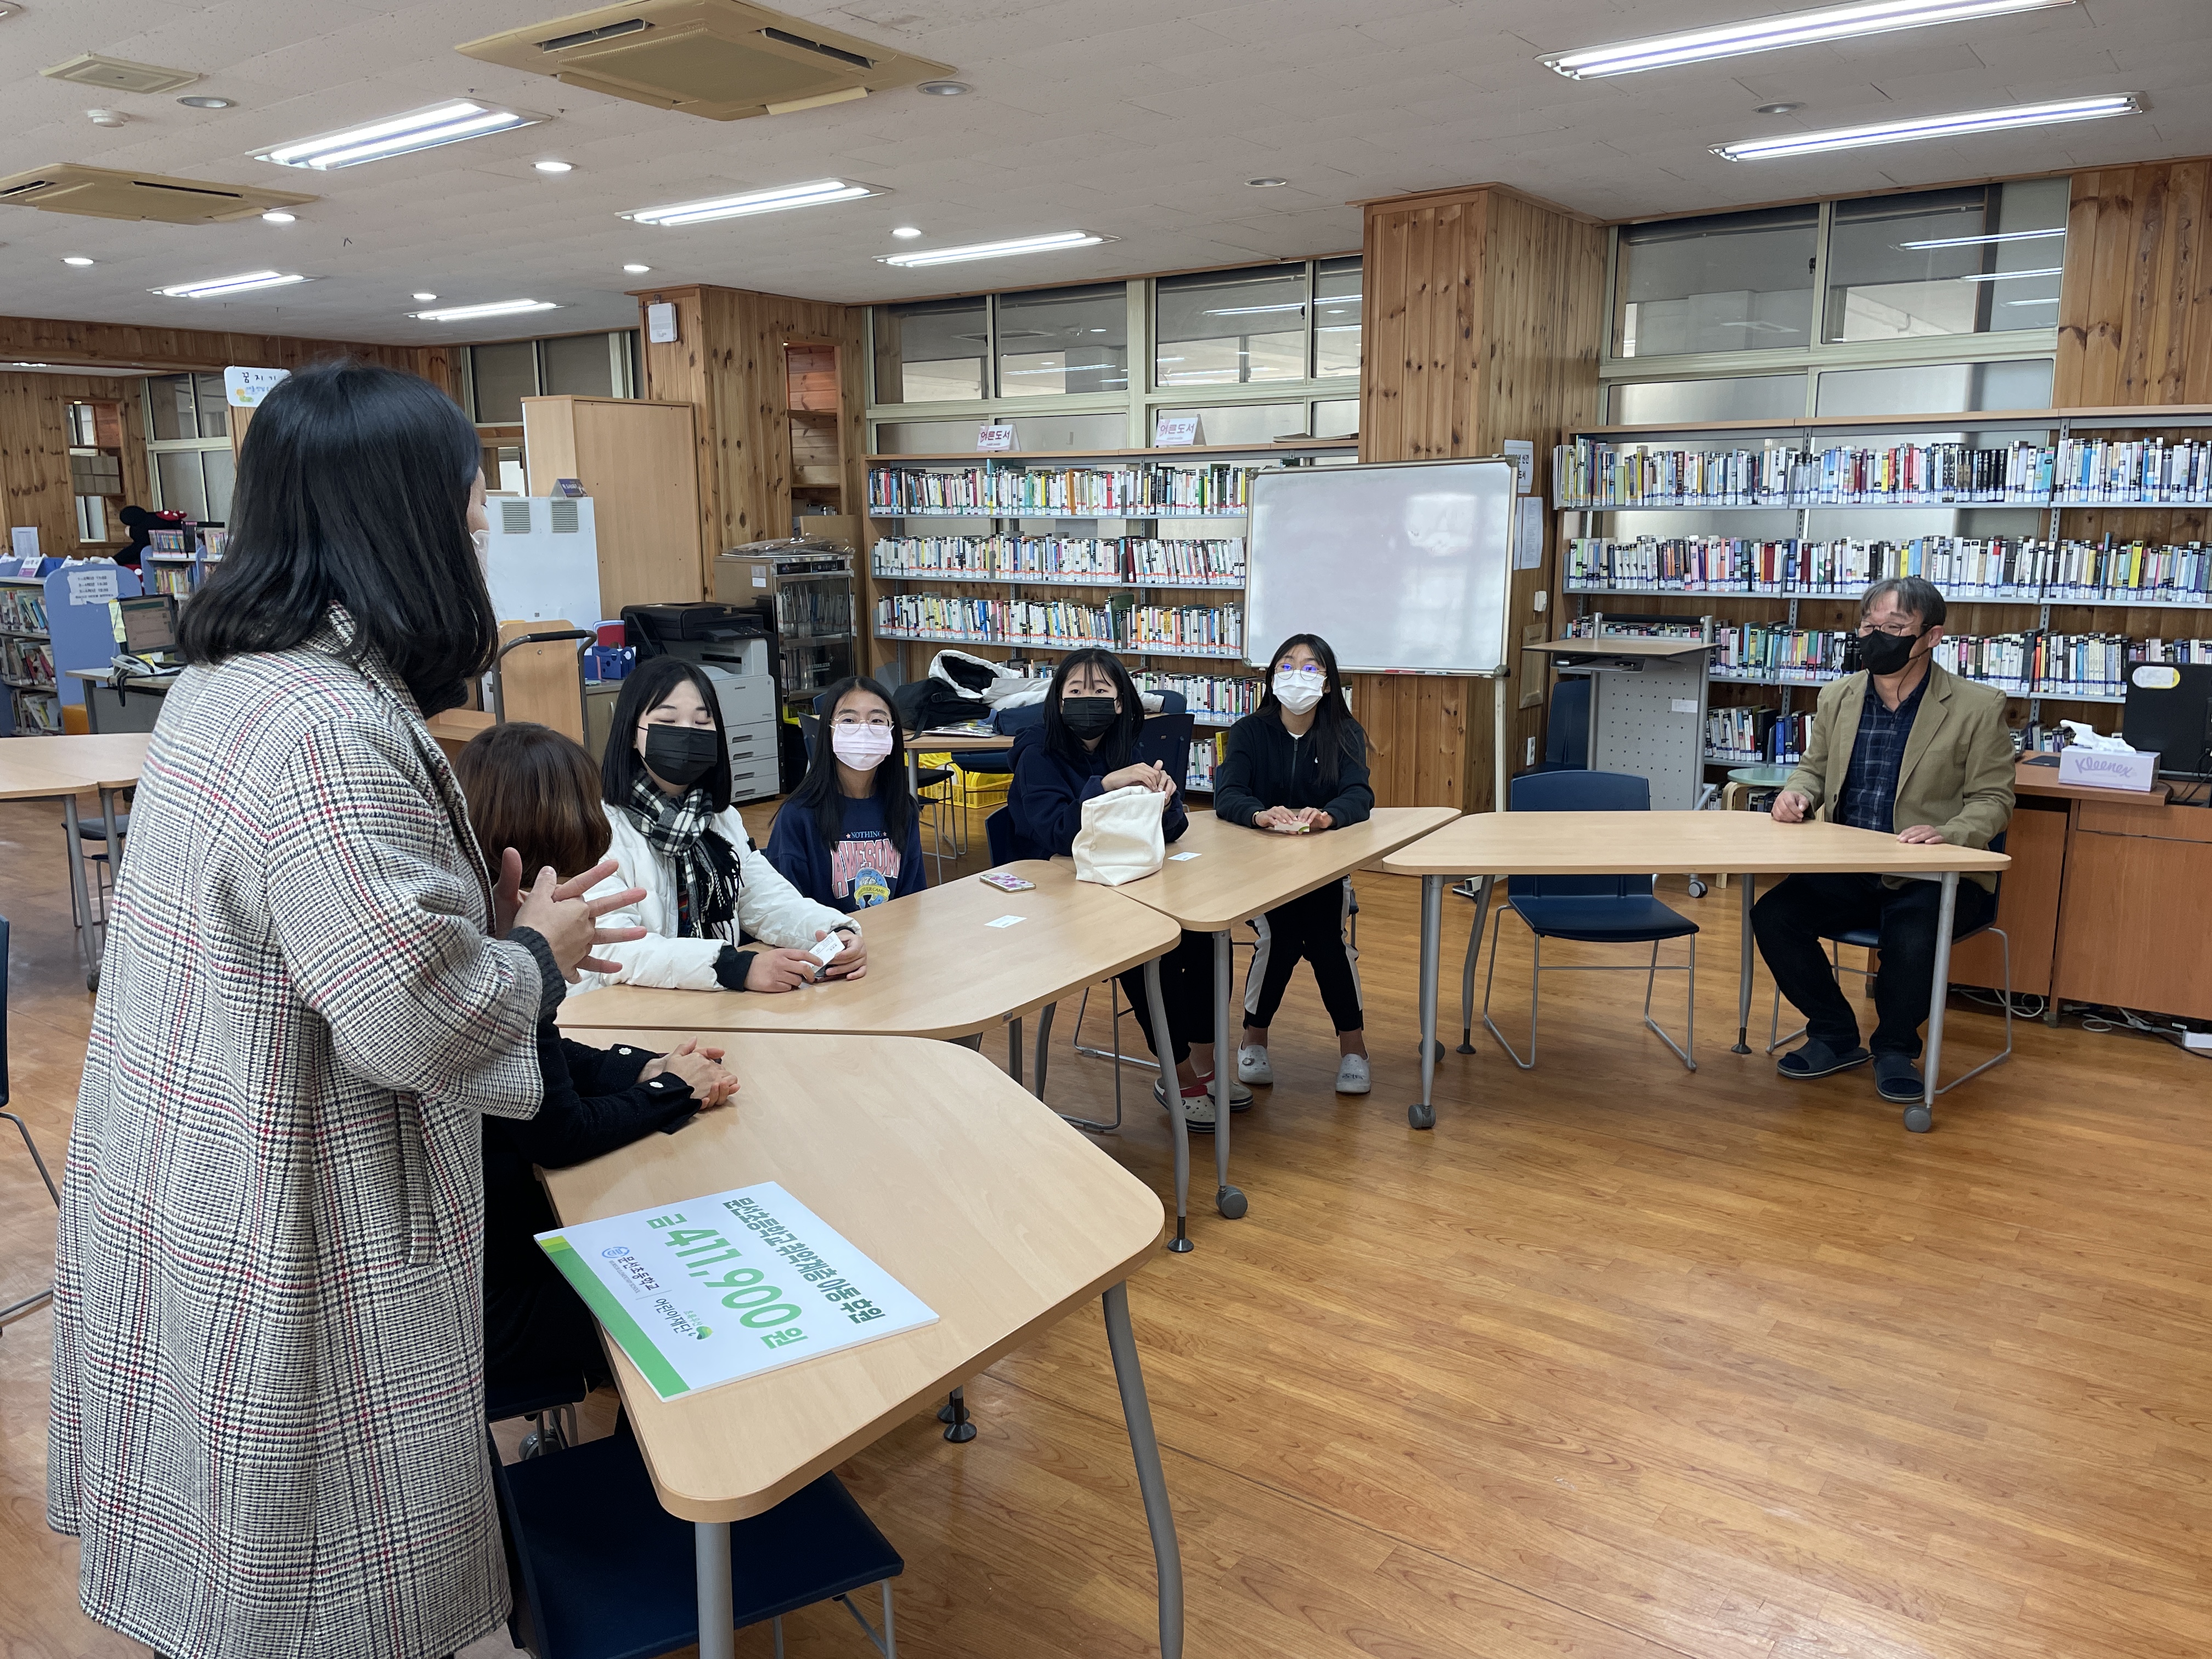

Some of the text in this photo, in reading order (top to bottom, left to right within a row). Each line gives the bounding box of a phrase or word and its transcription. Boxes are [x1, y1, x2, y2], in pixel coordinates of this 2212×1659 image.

[980, 430, 1011, 441] 어른도서
[1160, 424, 1195, 435] 어른도서
[2075, 756, 2133, 778] Kleenex
[851, 831, 882, 839] NOTHING
[830, 838, 901, 899] AWESOM
[618, 1256, 660, 1291] 문선초등학교
[722, 1197, 886, 1324] 문선초등학교 취약계층 아동 후원
[646, 1213, 809, 1350] 금 411,900 원
[654, 1298, 693, 1334] 어린이재단
